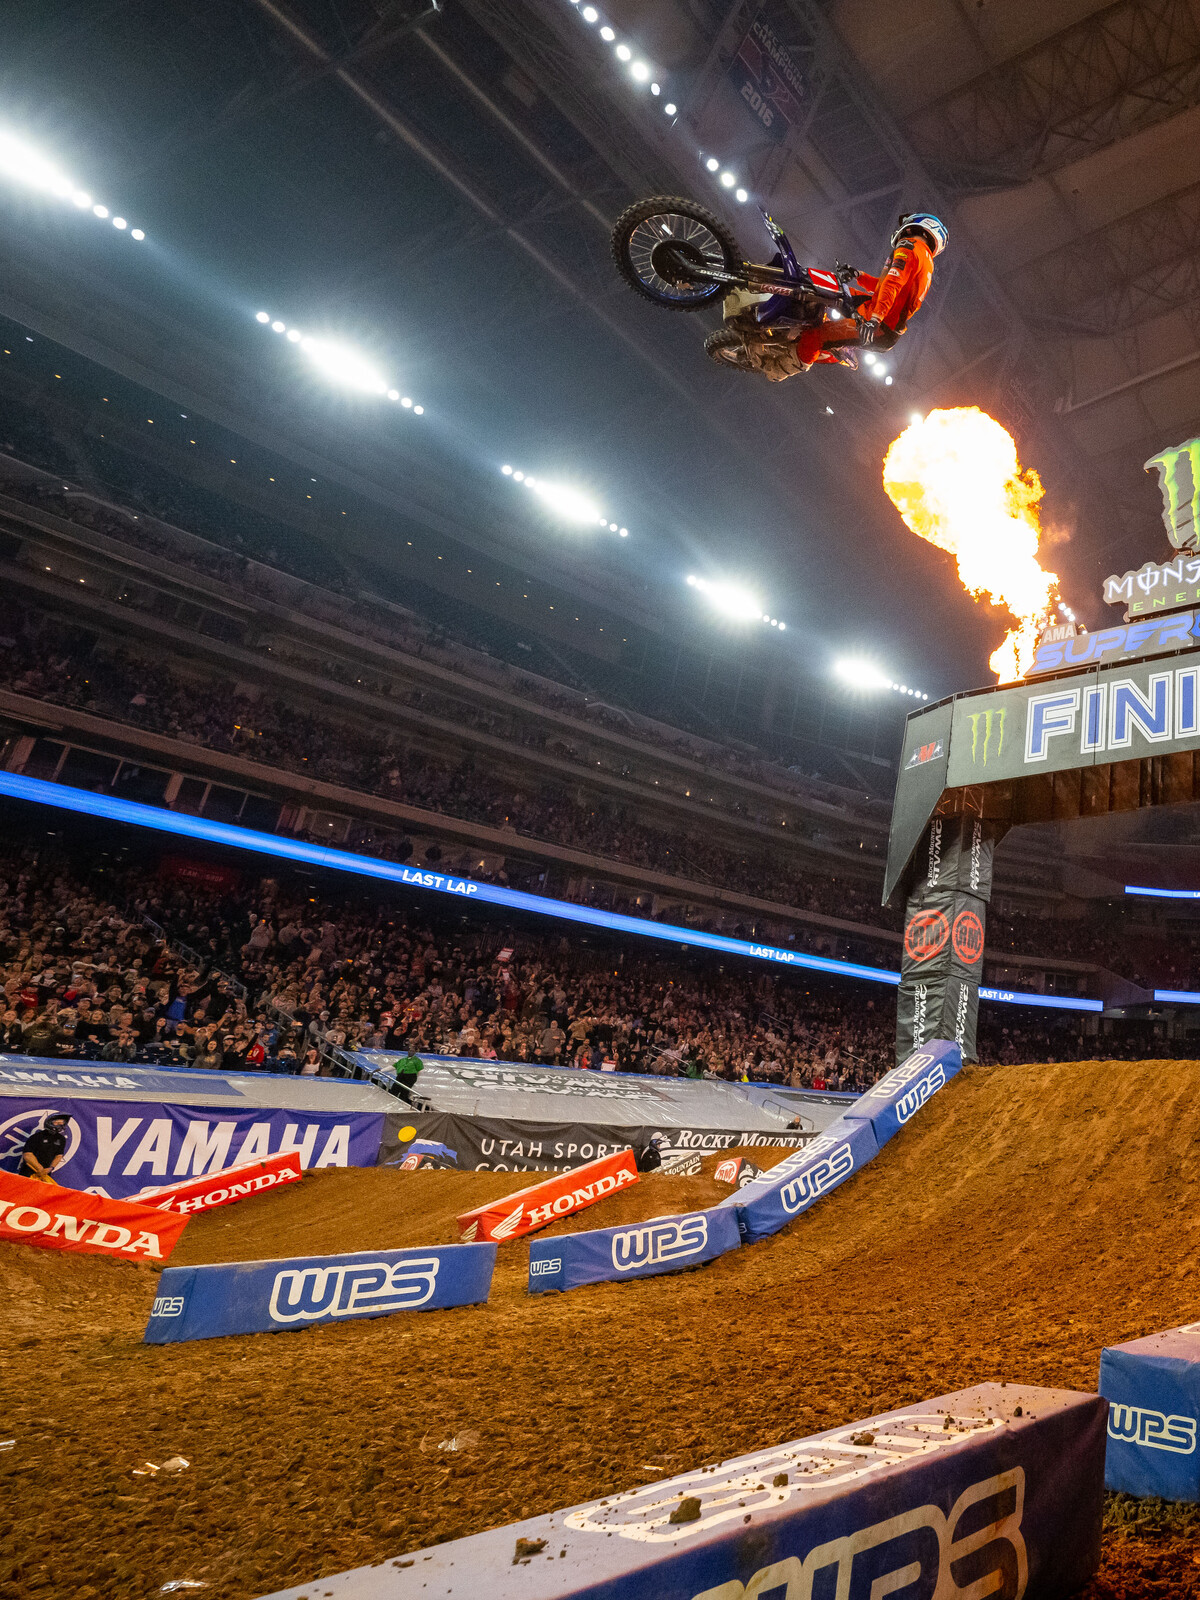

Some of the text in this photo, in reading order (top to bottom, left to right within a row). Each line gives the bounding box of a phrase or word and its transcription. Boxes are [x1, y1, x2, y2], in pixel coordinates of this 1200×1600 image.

[740, 80, 774, 127] 2016
[699, 269, 738, 280] DUNLOP
[1044, 622, 1076, 644] AMA
[402, 869, 478, 896] LAST LAP
[749, 945, 795, 963] LAST LAP
[978, 988, 1014, 1001] LAST LAP
[870, 1053, 935, 1099] WPS
[896, 1063, 946, 1124] WPS
[91, 1116, 351, 1176] YAMAHA
[481, 1138, 543, 1157] UTAH
[674, 1130, 820, 1149] ROCKY MOUNTAI
[176, 1168, 300, 1215] HONDA
[529, 1167, 637, 1226] HONDA
[780, 1143, 854, 1214] WPS
[611, 1214, 709, 1272] WPS
[268, 1257, 440, 1323] WPS
[530, 1257, 562, 1277] WPS
[151, 1296, 185, 1318] WPS
[1107, 1401, 1197, 1455] WPS
[690, 1465, 1030, 1600] PS
